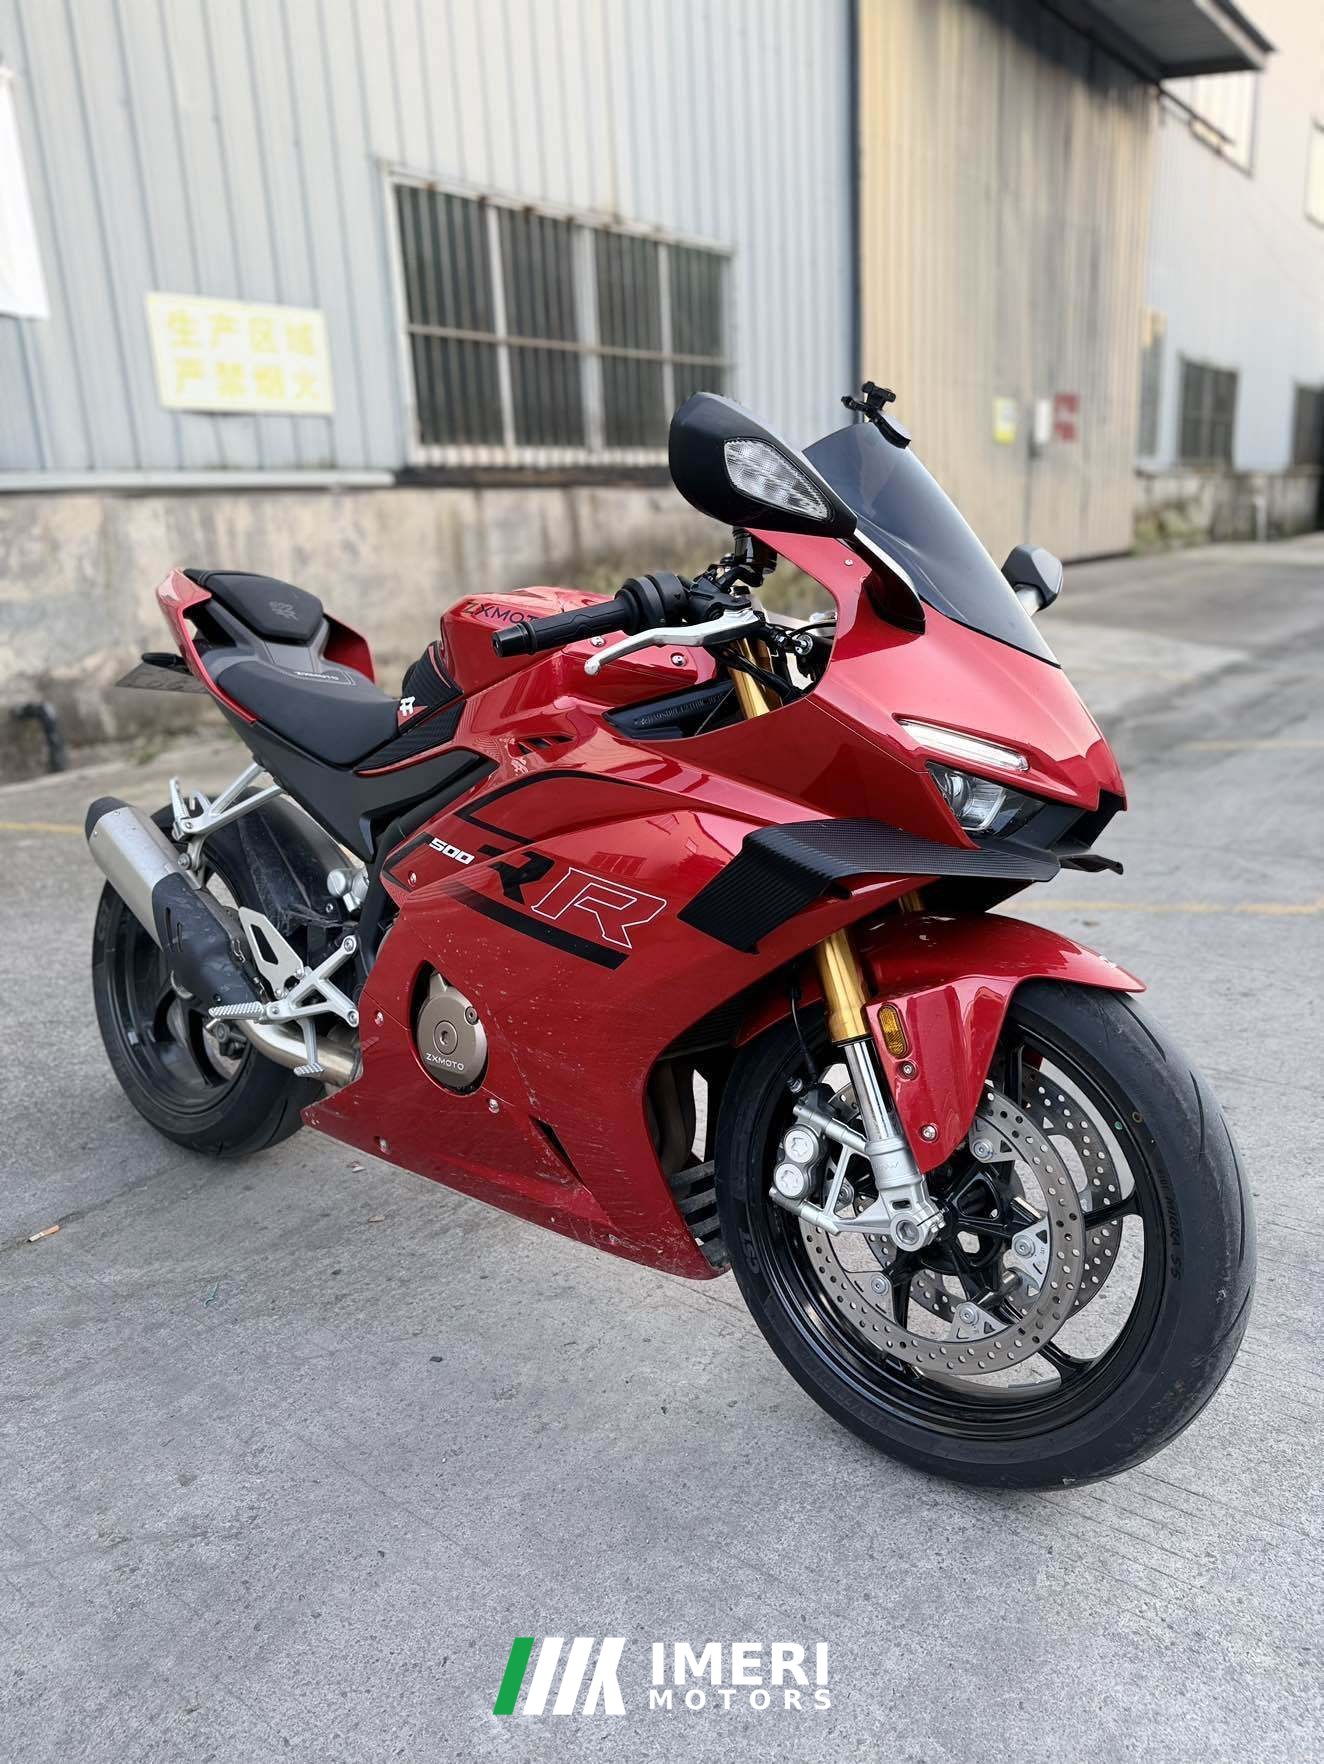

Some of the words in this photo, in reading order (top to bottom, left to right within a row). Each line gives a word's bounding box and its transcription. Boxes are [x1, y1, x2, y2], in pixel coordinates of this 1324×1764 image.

[464, 601, 540, 624] ZXMOT
[428, 837, 475, 864] 500
[426, 1052, 465, 1071] ZXMOTO
